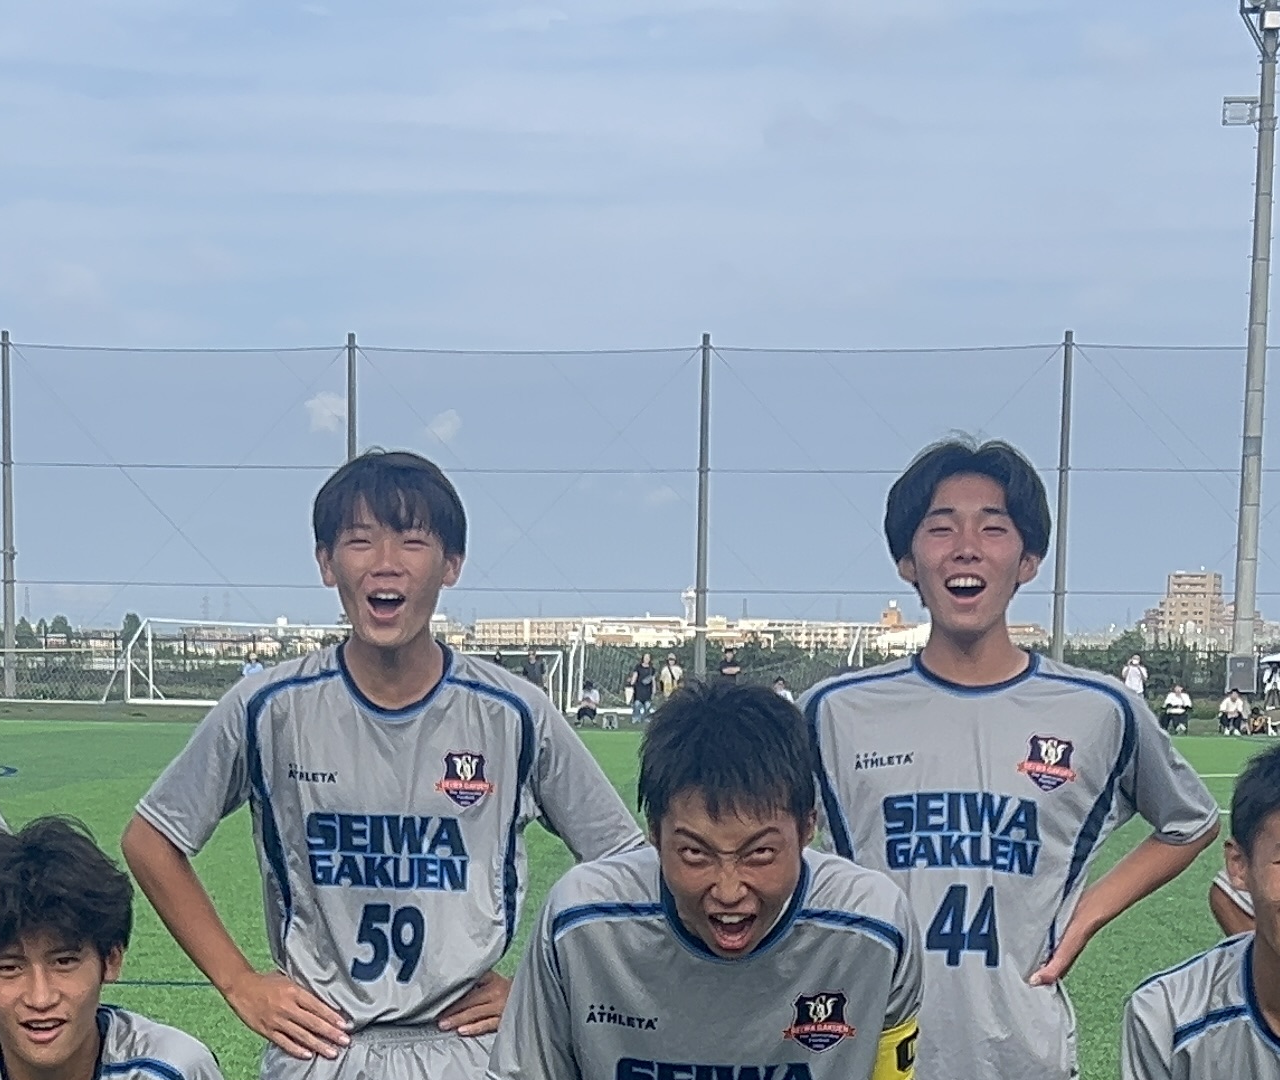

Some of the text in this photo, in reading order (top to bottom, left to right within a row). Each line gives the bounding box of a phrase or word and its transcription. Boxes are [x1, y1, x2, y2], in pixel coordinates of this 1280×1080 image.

[855, 752, 914, 771] ATHLETA
[306, 811, 469, 857] SEIWA
[881, 791, 1040, 841] SEIWA
[308, 854, 469, 893] GAKUEN
[886, 833, 1041, 877] GAKUEN
[350, 903, 426, 985] 59
[925, 883, 1000, 968] 44
[586, 1011, 658, 1031] ATHLETA
